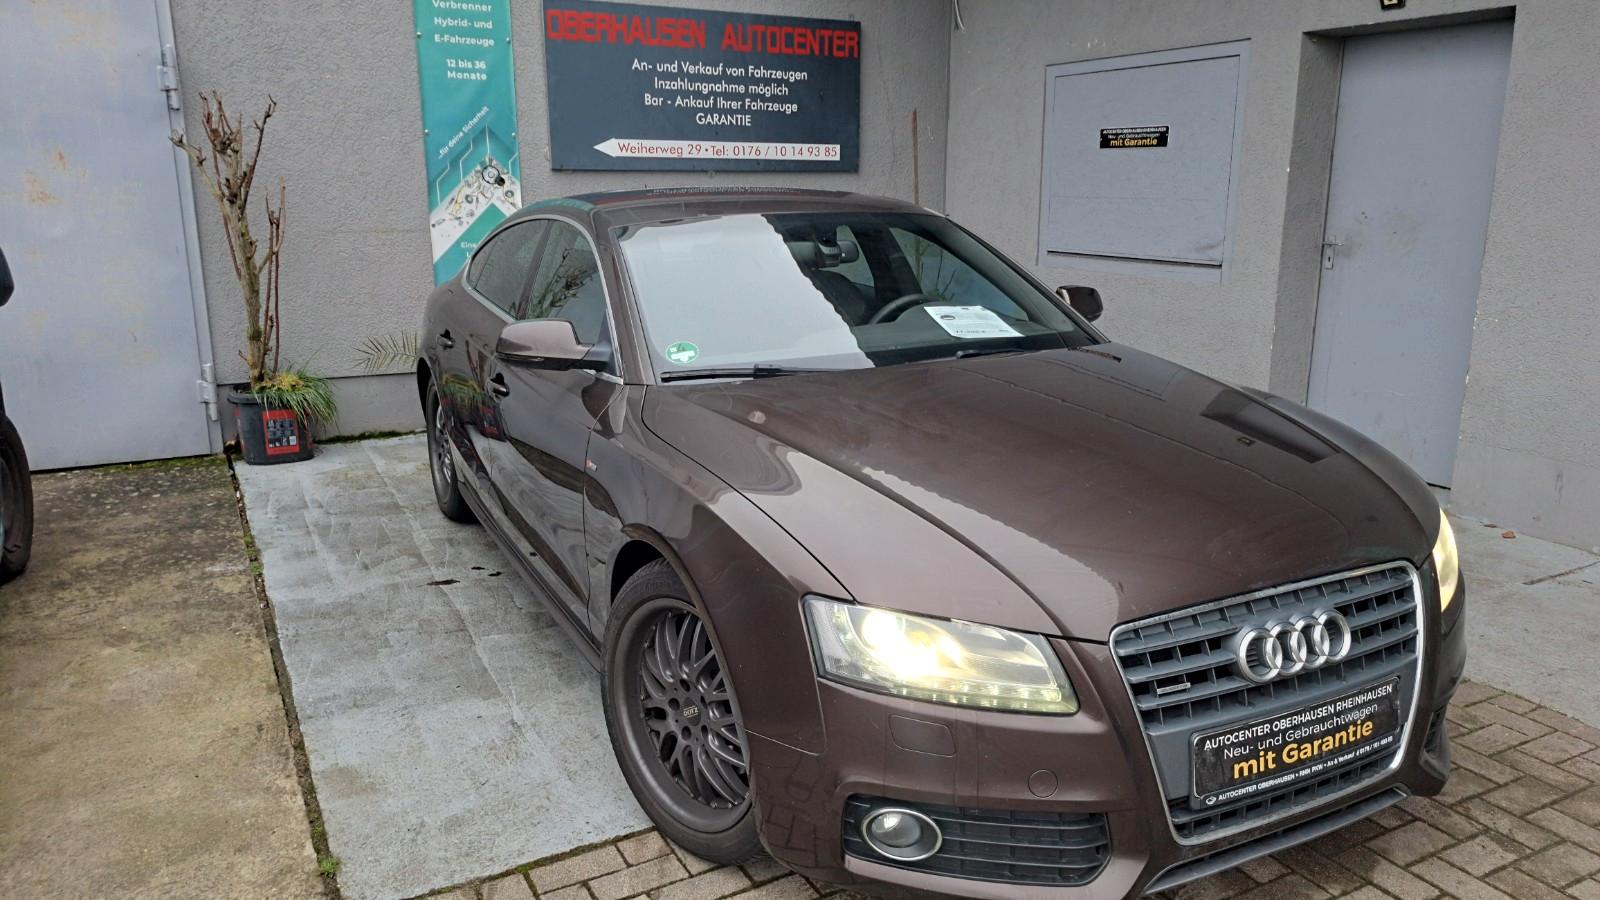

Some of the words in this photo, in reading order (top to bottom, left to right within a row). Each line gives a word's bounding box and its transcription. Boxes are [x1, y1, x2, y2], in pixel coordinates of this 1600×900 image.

[432, 0, 492, 12] Verbrenner
[434, 17, 472, 27] Hybrid-
[474, 20, 492, 29] und
[434, 34, 494, 47] E-Fahrzeuge
[546, 8, 706, 48] OBERHAUSEN
[722, 22, 858, 58] AUTOCENTER
[446, 59, 456, 67] 12
[458, 59, 472, 68] bis
[474, 60, 486, 69] 36
[632, 58, 652, 70] An-
[656, 60, 678, 72] und
[681, 62, 723, 76] Verkauf
[726, 68, 745, 76] von
[748, 66, 808, 82] Fahrzeugen
[447, 71, 487, 80] Monate
[654, 77, 745, 94] Inzahlungnahme
[749, 82, 788, 97] möglich
[644, 94, 663, 106] Bar
[675, 95, 714, 108] Ankauf
[718, 98, 742, 110] Ihrer
[746, 99, 798, 114] Fahrzeuge
[696, 113, 751, 126] GARANTIE
[617, 142, 684, 156] Weiherweg
[688, 143, 702, 155] 29
[711, 145, 729, 156] Tel:
[733, 145, 761, 157] 0176
[774, 146, 787, 157] 10
[792, 146, 804, 157] 14
[808, 146, 820, 157] 93
[825, 146, 837, 157] 85
[1110, 138, 1123, 146] mit
[1124, 138, 1158, 146] Garantie
[1204, 724, 1271, 750] AUTOCENTER
[1272, 704, 1335, 731] OBERHAUSEN
[1336, 684, 1392, 712] RHEINHAUSEN
[1224, 745, 1254, 760] Neu-
[1258, 733, 1282, 750] und
[1286, 704, 1378, 741] Gebrauchtwagen
[1234, 751, 1276, 779] mit
[1282, 720, 1373, 764] Garantie
[1218, 785, 1257, 800] AUTOCENTER
[1258, 773, 1295, 789] OBERHAUSEN
